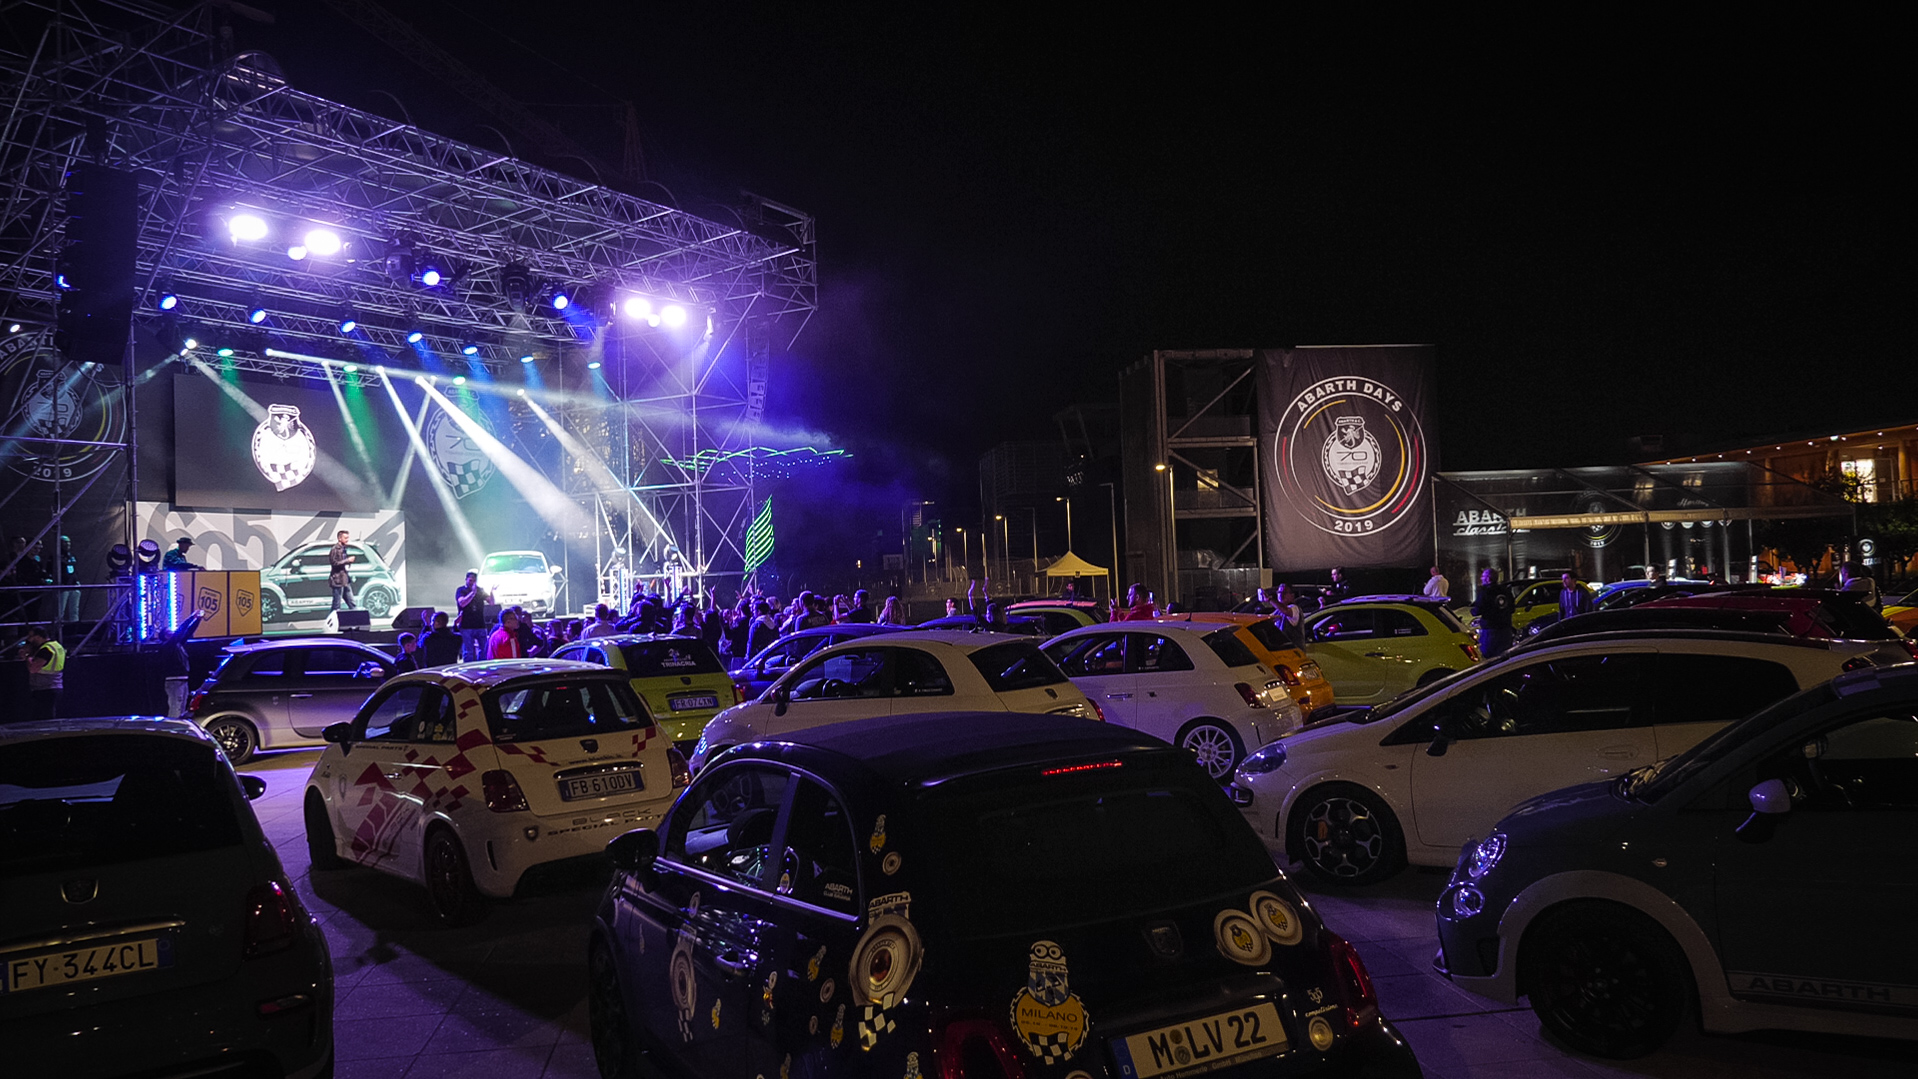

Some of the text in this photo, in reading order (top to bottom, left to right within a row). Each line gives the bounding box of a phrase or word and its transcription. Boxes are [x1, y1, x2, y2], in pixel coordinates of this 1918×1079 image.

[1296, 380, 1403, 413] ABARTH DAYS
[1336, 451, 1367, 461] 70
[1334, 520, 1374, 532] 2019
[200, 596, 218, 611] 105
[238, 596, 252, 608] 105
[676, 700, 686, 708] FR
[571, 774, 634, 796] FB 610DV
[825, 883, 853, 894] ABARTH
[870, 895, 908, 907] ABARTH
[13, 943, 153, 989] FY 344CL
[1030, 962, 1067, 971] ABARTH
[1748, 977, 1891, 1001] ABARTH
[1022, 1008, 1078, 1023] MILANO
[1148, 1011, 1268, 1069] M LV 22
[1123, 1064, 1132, 1076] D
